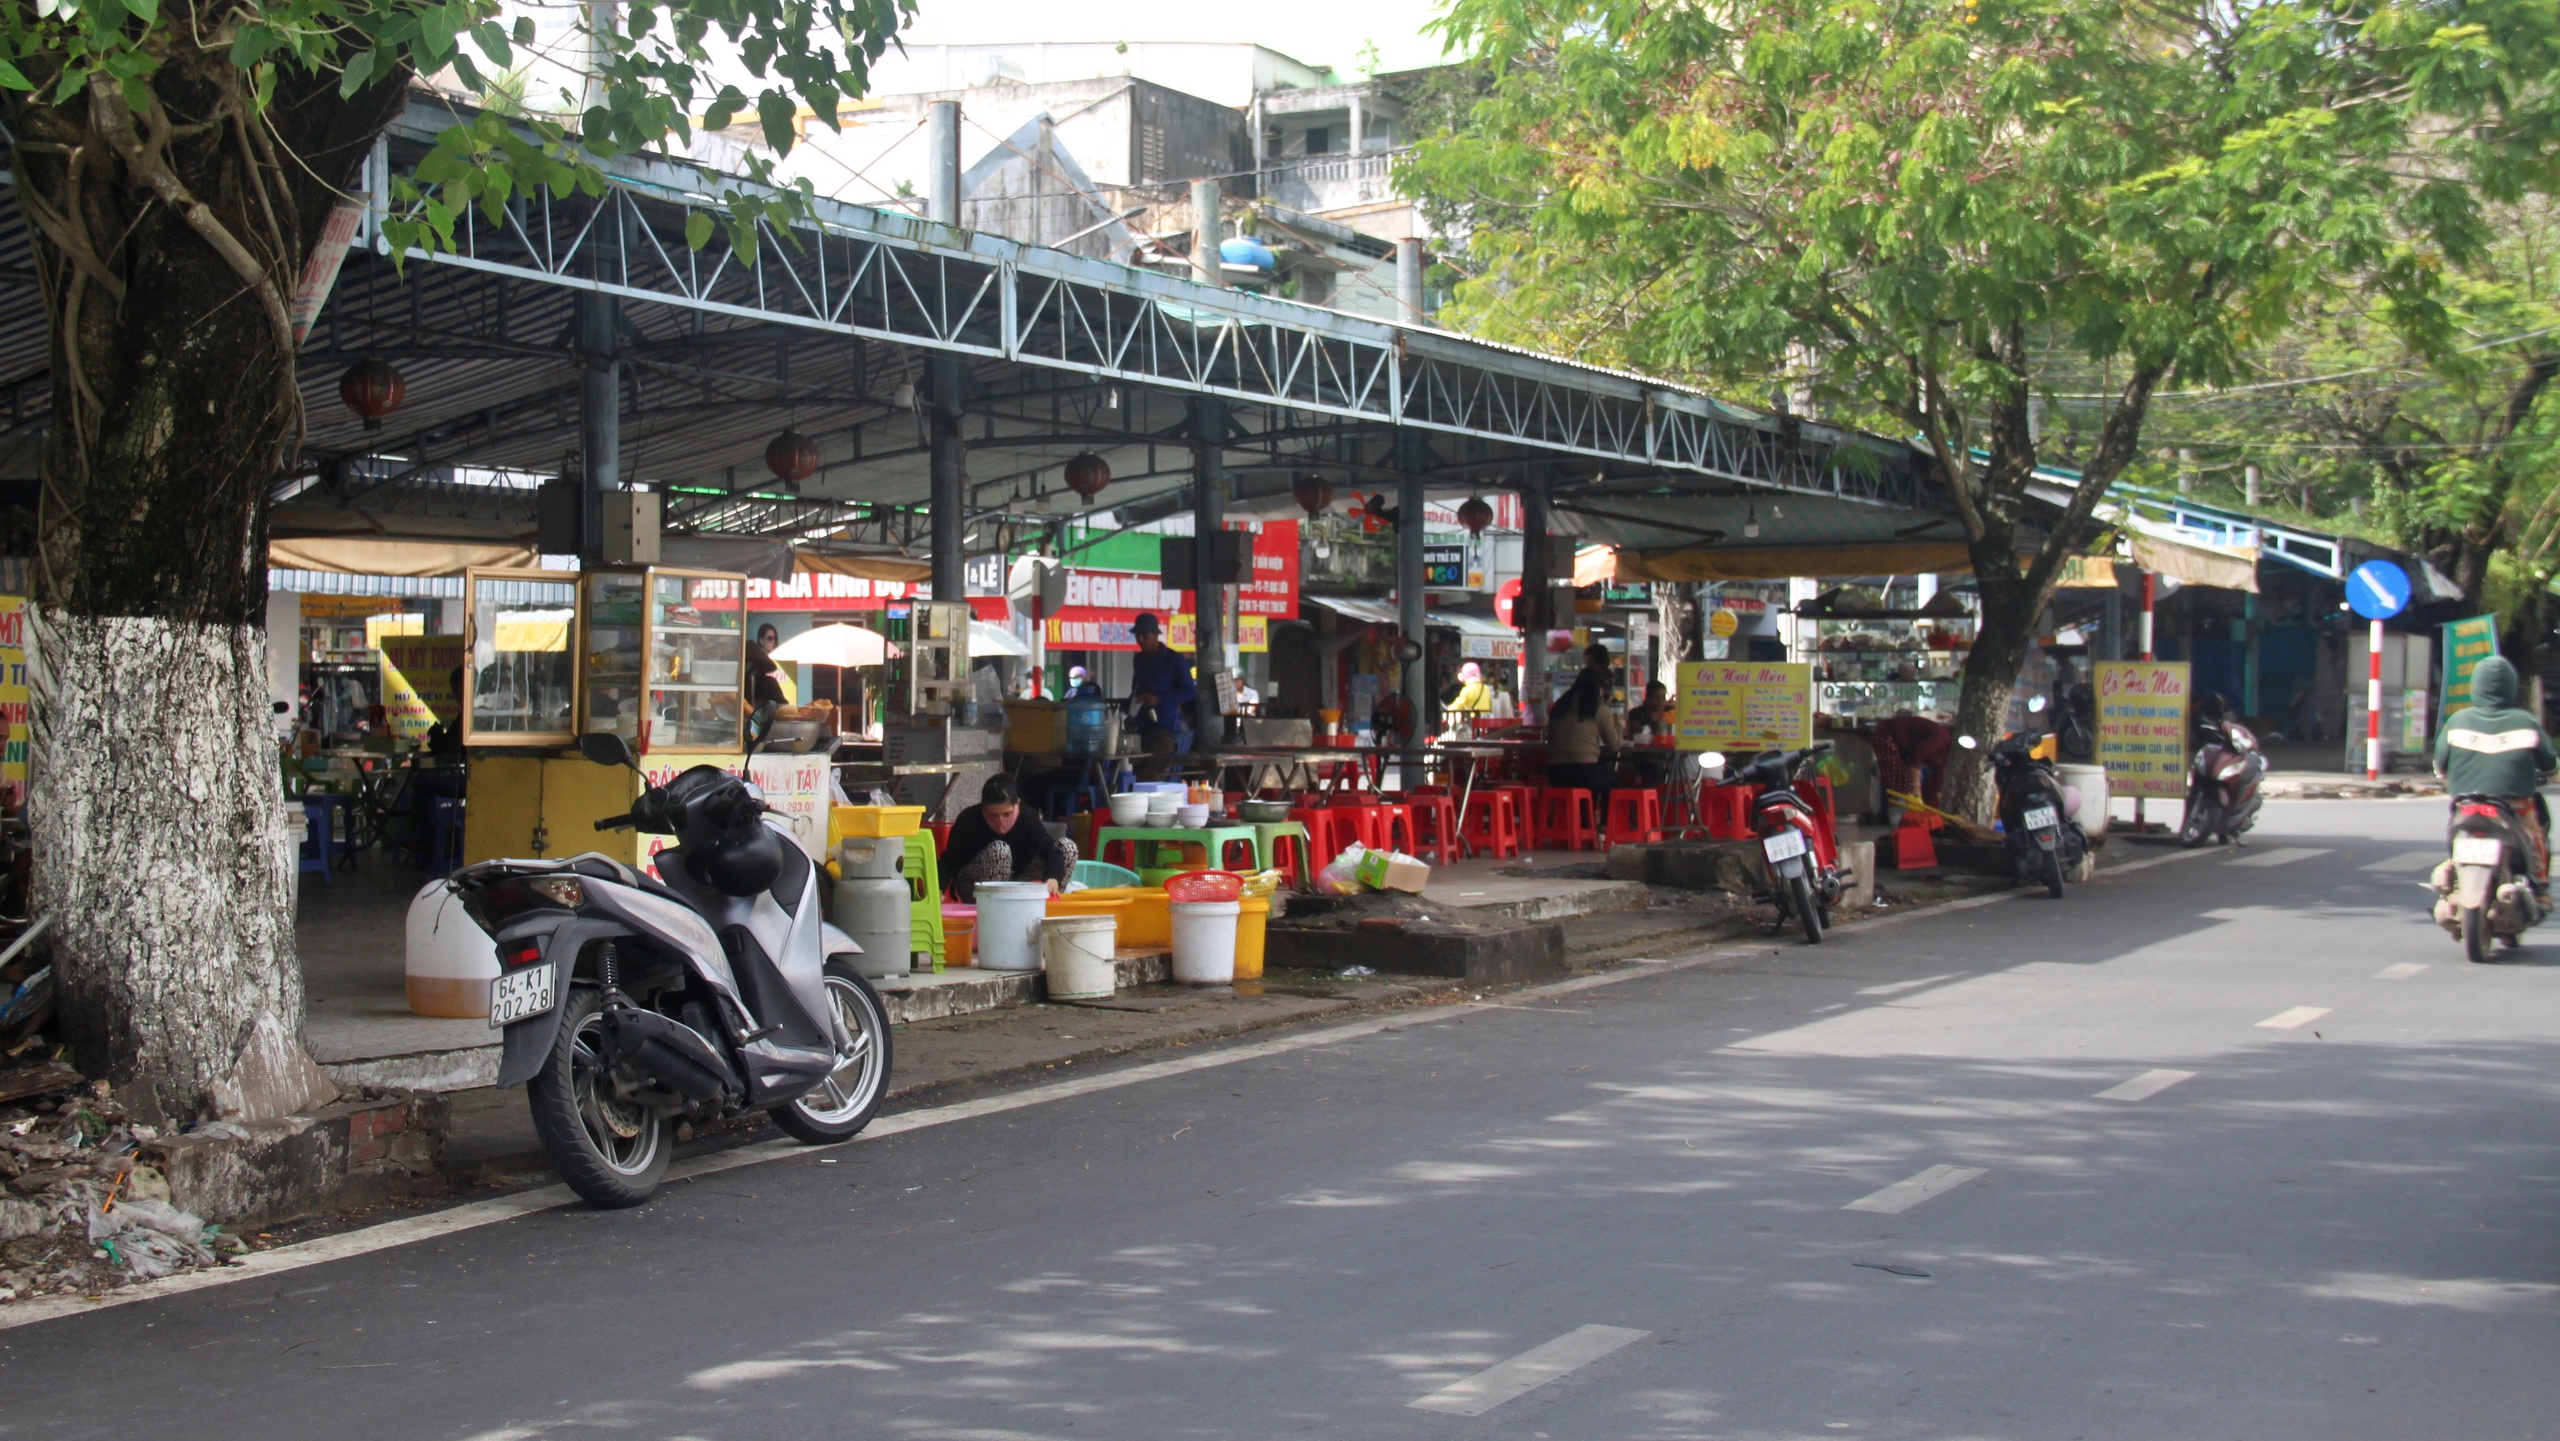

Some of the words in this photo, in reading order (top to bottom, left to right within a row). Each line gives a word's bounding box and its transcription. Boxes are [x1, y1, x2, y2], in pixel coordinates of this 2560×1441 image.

[980, 555, 997, 587] LẺ
[795, 763, 822, 790] TÂY
[499, 968, 542, 999] 64-K1
[493, 988, 549, 1024] 202.28
